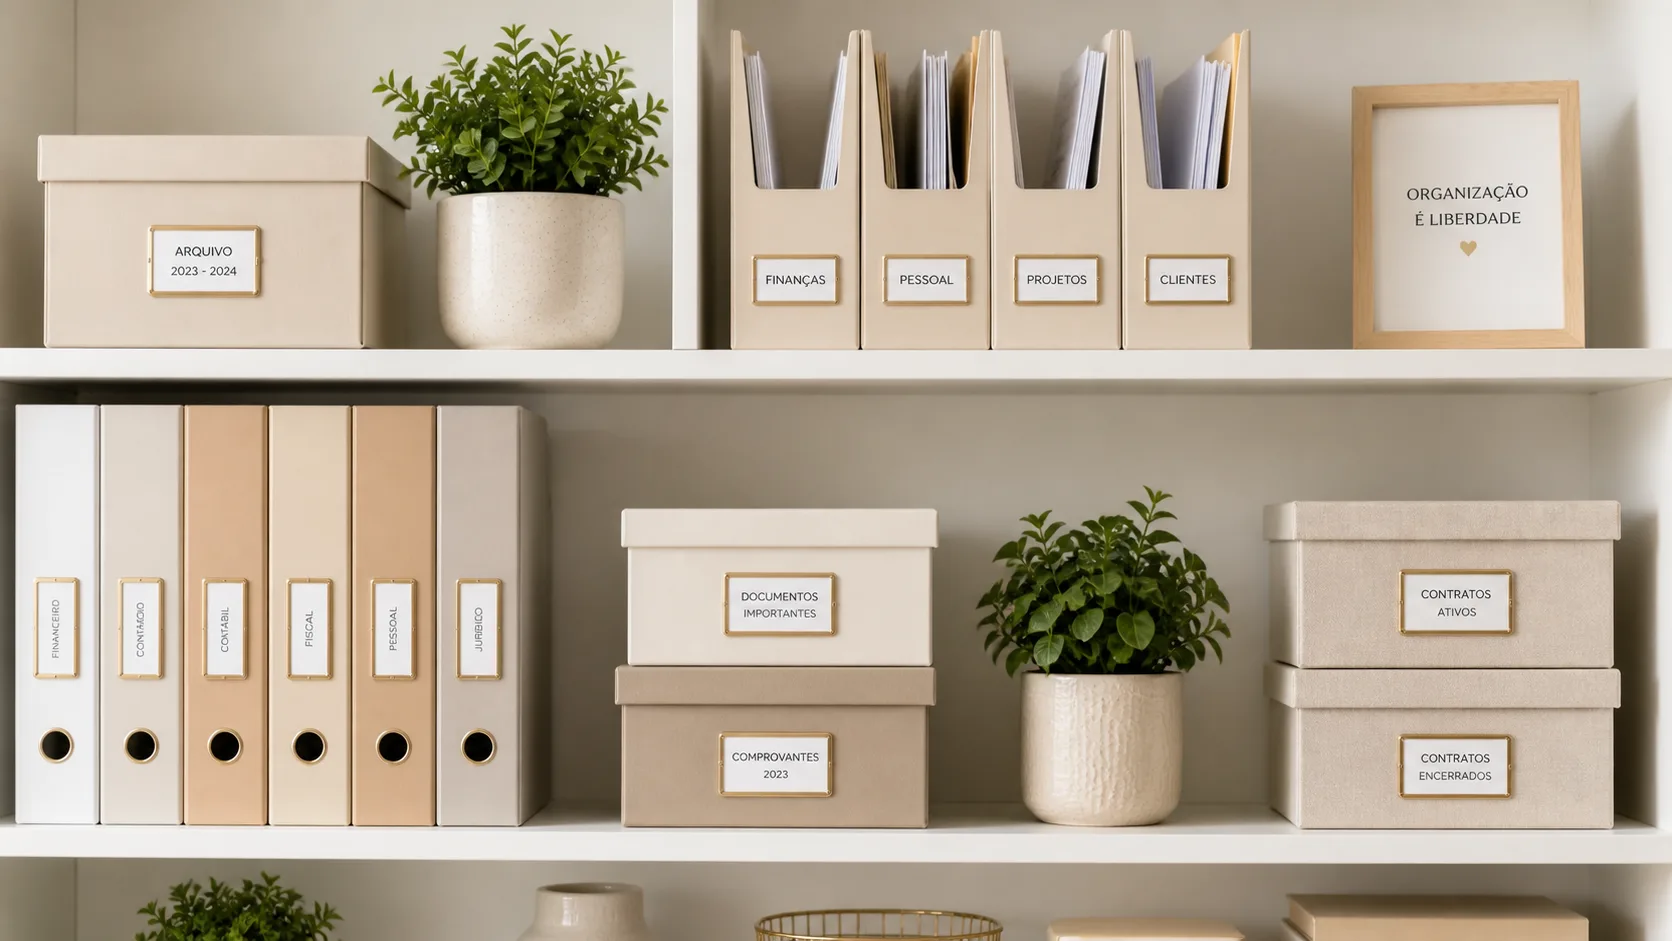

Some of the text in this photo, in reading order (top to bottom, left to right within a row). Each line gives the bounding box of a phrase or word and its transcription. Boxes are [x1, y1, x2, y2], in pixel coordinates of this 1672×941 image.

[1406, 183, 1529, 202] ORGANIZAÇÃO
[1414, 210, 1522, 227] É LIBERDADE
[174, 245, 233, 258] ARQUIVO
[170, 265, 199, 277] 2023
[209, 265, 238, 277] 2024
[765, 274, 826, 288] FINANÇAS
[899, 274, 955, 286] PESSOAL
[1026, 274, 1088, 286] PROJETOS
[1159, 274, 1217, 285] CLIENTES
[740, 591, 819, 602] DOCUMENTOS
[1420, 588, 1492, 600] CONTRATOS
[743, 608, 817, 619] IMPORTANTES
[1437, 607, 1477, 618] ATIVOS
[51, 599, 60, 659] FINANCEIRO
[304, 610, 314, 648] FISCAL
[388, 606, 398, 651] PESSOAL
[731, 751, 820, 763] COMPROVANTES
[1420, 753, 1491, 764] CONTRATOS
[763, 769, 789, 780] 2023
[1418, 770, 1492, 781] ENCERRADOS
